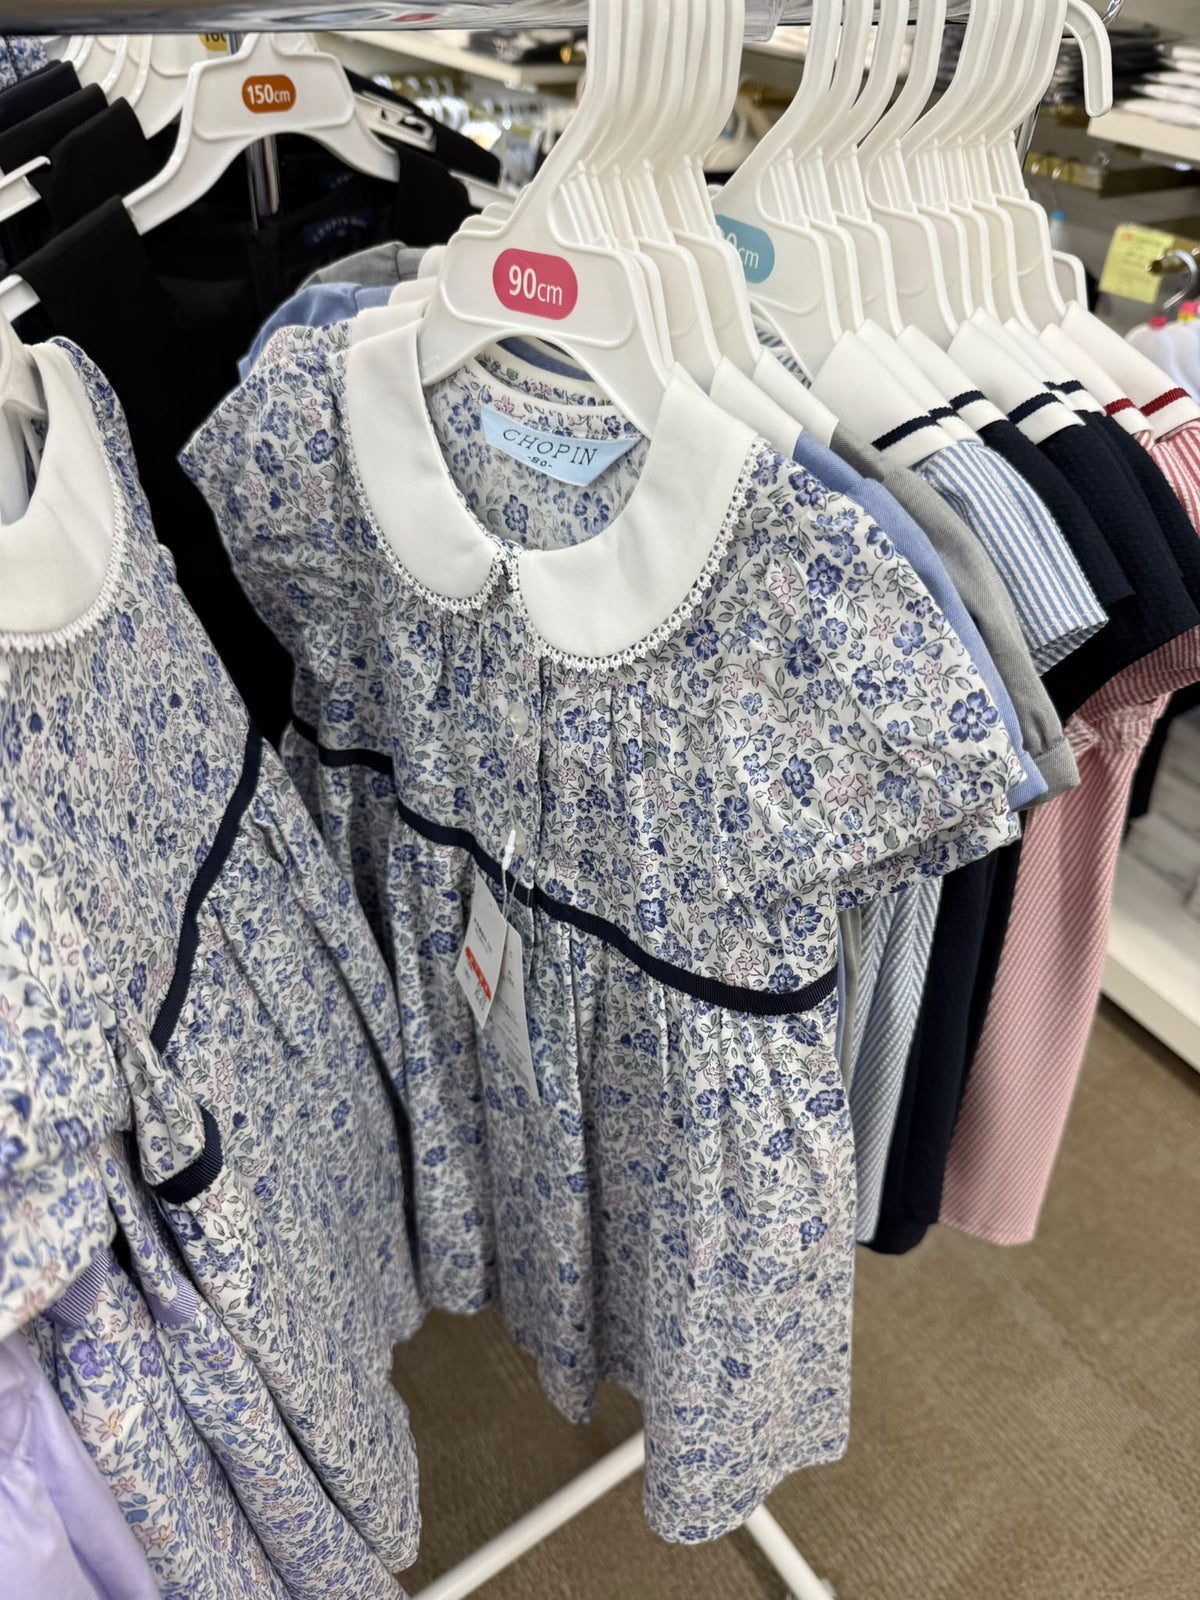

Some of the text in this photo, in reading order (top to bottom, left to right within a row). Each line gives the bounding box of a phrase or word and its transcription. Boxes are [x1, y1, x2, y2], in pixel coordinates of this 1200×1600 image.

[247, 84, 291, 105] 150cm
[508, 264, 563, 306] 90cm
[502, 428, 598, 466] CHOPIN
